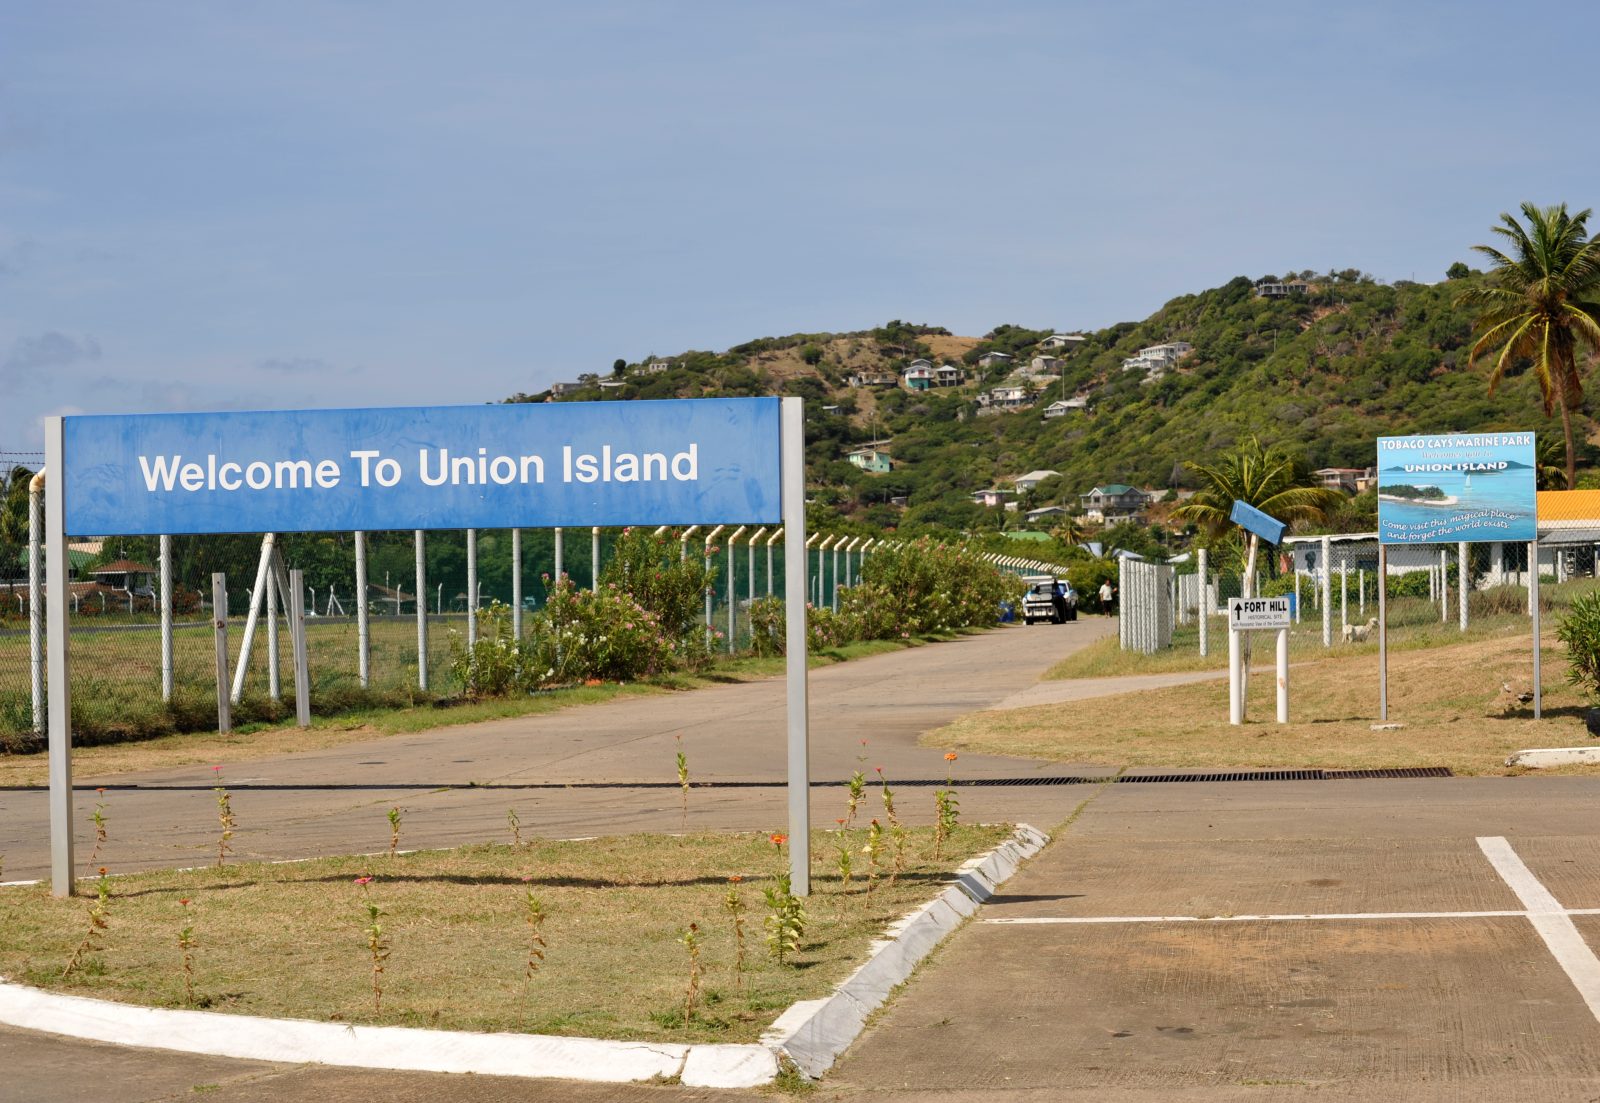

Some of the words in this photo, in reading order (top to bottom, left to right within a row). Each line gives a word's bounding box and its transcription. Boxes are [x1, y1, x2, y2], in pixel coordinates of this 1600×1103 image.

[1381, 439, 1425, 450] TOBAGO
[1427, 437, 1453, 449] CAYS
[1455, 436, 1499, 448] MARINE
[1502, 435, 1531, 446] PARK
[138, 454, 341, 492] Welcome
[350, 450, 402, 488] To
[418, 447, 545, 486] Union
[562, 443, 699, 483] Island
[1404, 463, 1453, 473] UNION
[1457, 461, 1508, 471] ISLAND
[1382, 519, 1408, 530] Come
[1409, 521, 1428, 530] visit
[1430, 518, 1447, 528] this
[1450, 509, 1490, 523] magical
[1490, 509, 1517, 520] place
[1387, 531, 1408, 540] and
[1408, 530, 1437, 541] forget
[1438, 526, 1454, 536] the
[1455, 520, 1482, 531] world
[1244, 602, 1266, 612] FORT
[1270, 601, 1287, 612] HILL
